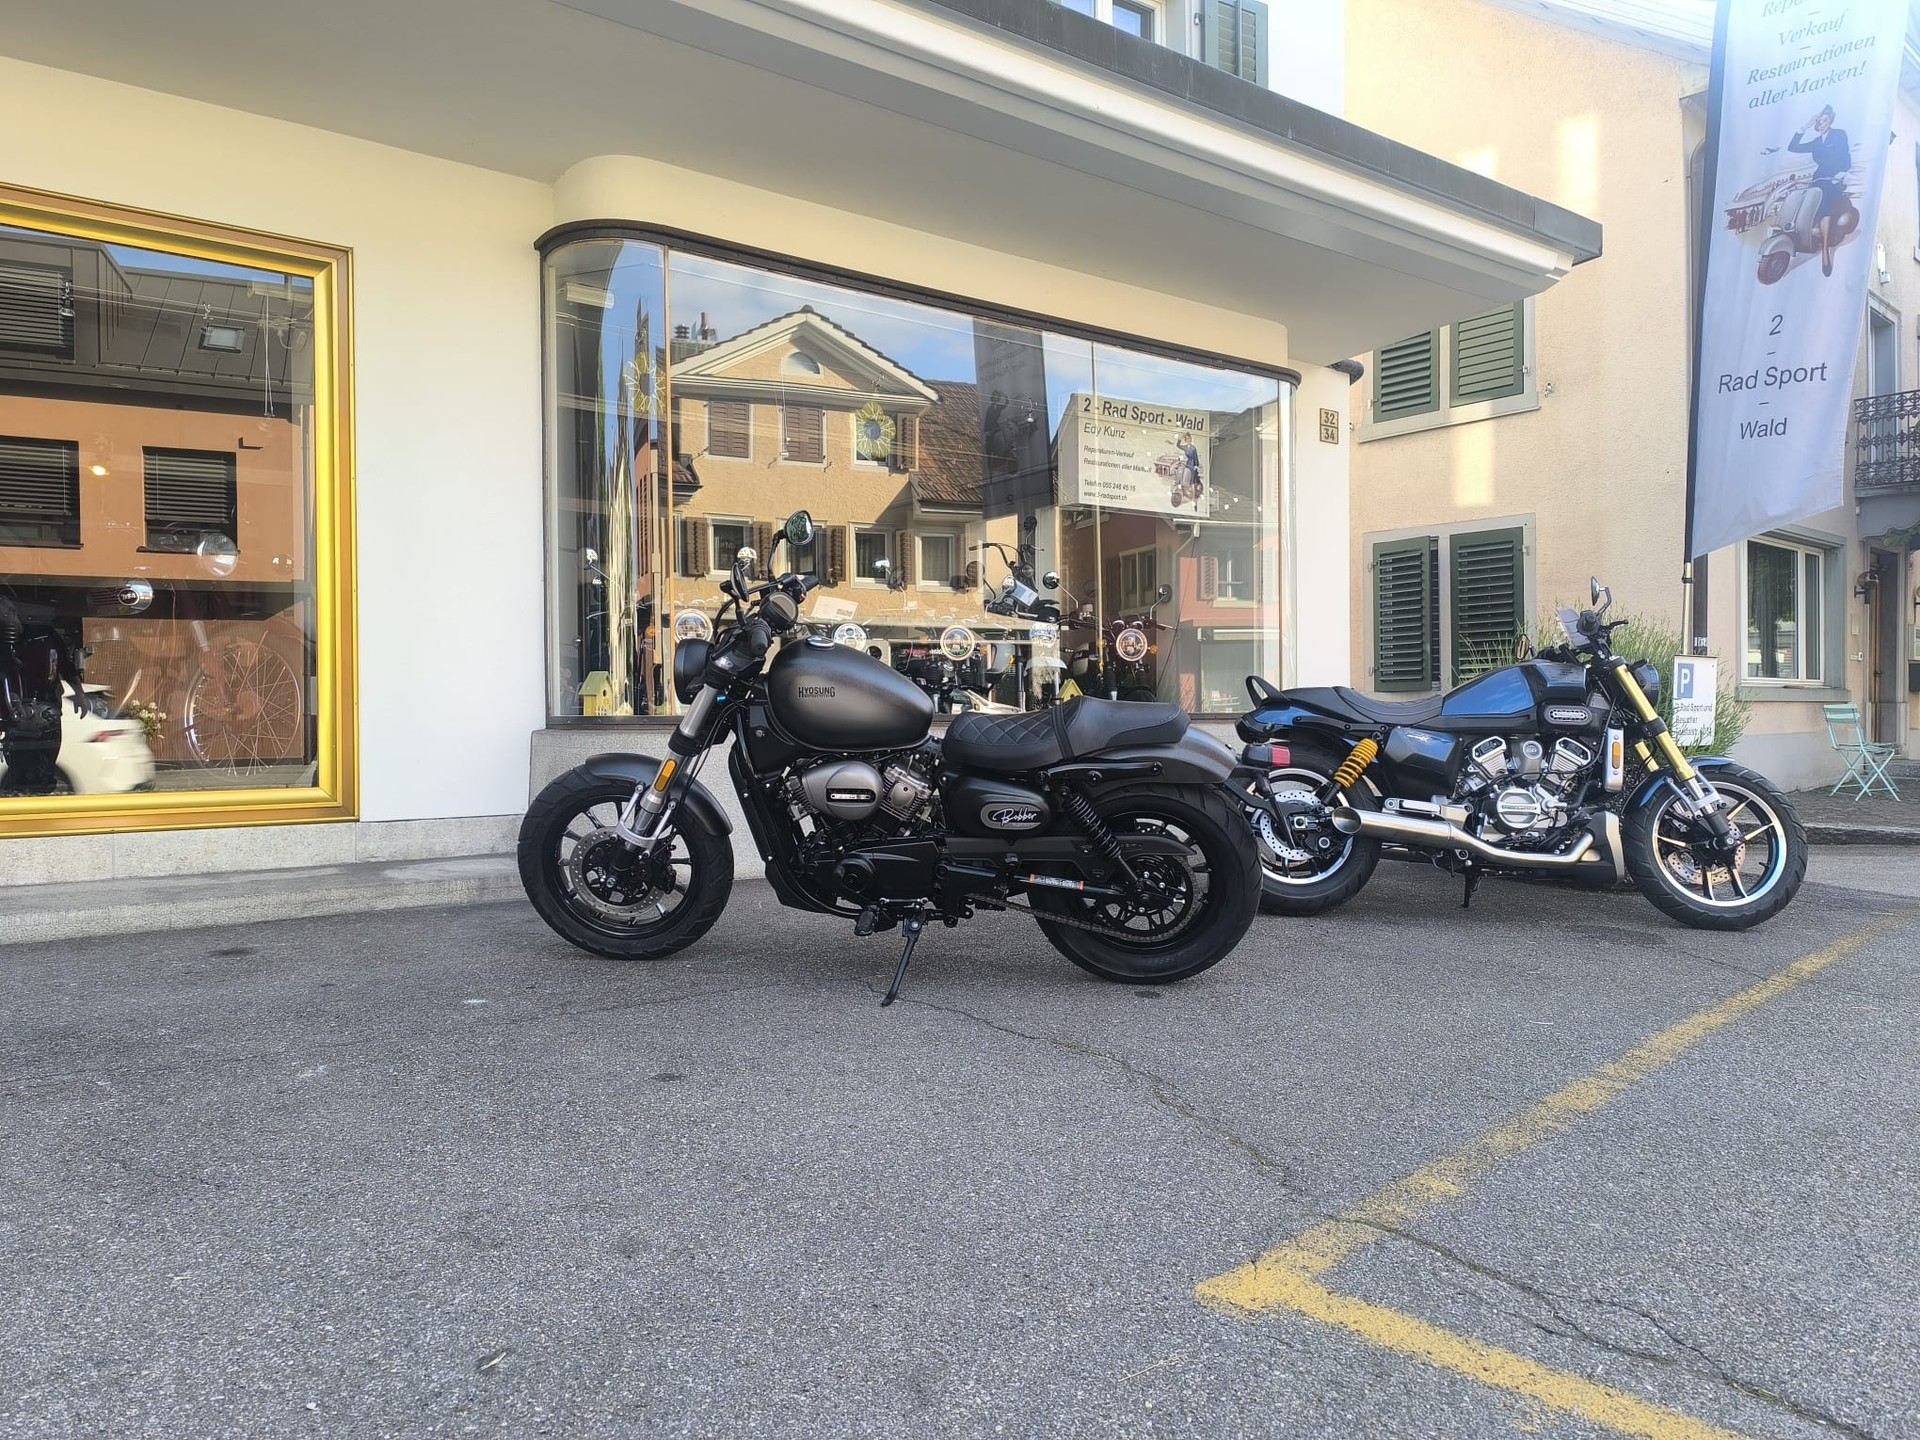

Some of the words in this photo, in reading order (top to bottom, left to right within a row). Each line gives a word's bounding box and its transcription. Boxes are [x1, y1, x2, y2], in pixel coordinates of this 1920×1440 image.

[1778, 8, 1850, 46] Verkauf
[1746, 35, 1876, 85] Restaurationen
[1748, 88, 1788, 109] aller
[1789, 60, 1867, 97] Marken!
[1769, 314, 1784, 336] 2
[1718, 370, 1759, 394] Rad
[1764, 362, 1828, 390] Sport
[1084, 397, 1092, 412] 2
[1102, 400, 1128, 418] Rad
[1131, 406, 1165, 424] Sport
[1175, 413, 1204, 431] Wald
[1324, 411, 1335, 425] 32
[1103, 425, 1126, 439] Kunz
[1324, 427, 1335, 441] 34
[1740, 417, 1788, 440] Wald
[1083, 457, 1121, 469] Resturationen
[1084, 479, 1102, 487] Telefn
[798, 686, 836, 698] HYOSUNG
[1680, 668, 1691, 694] P
[992, 807, 1037, 827] Bobber
